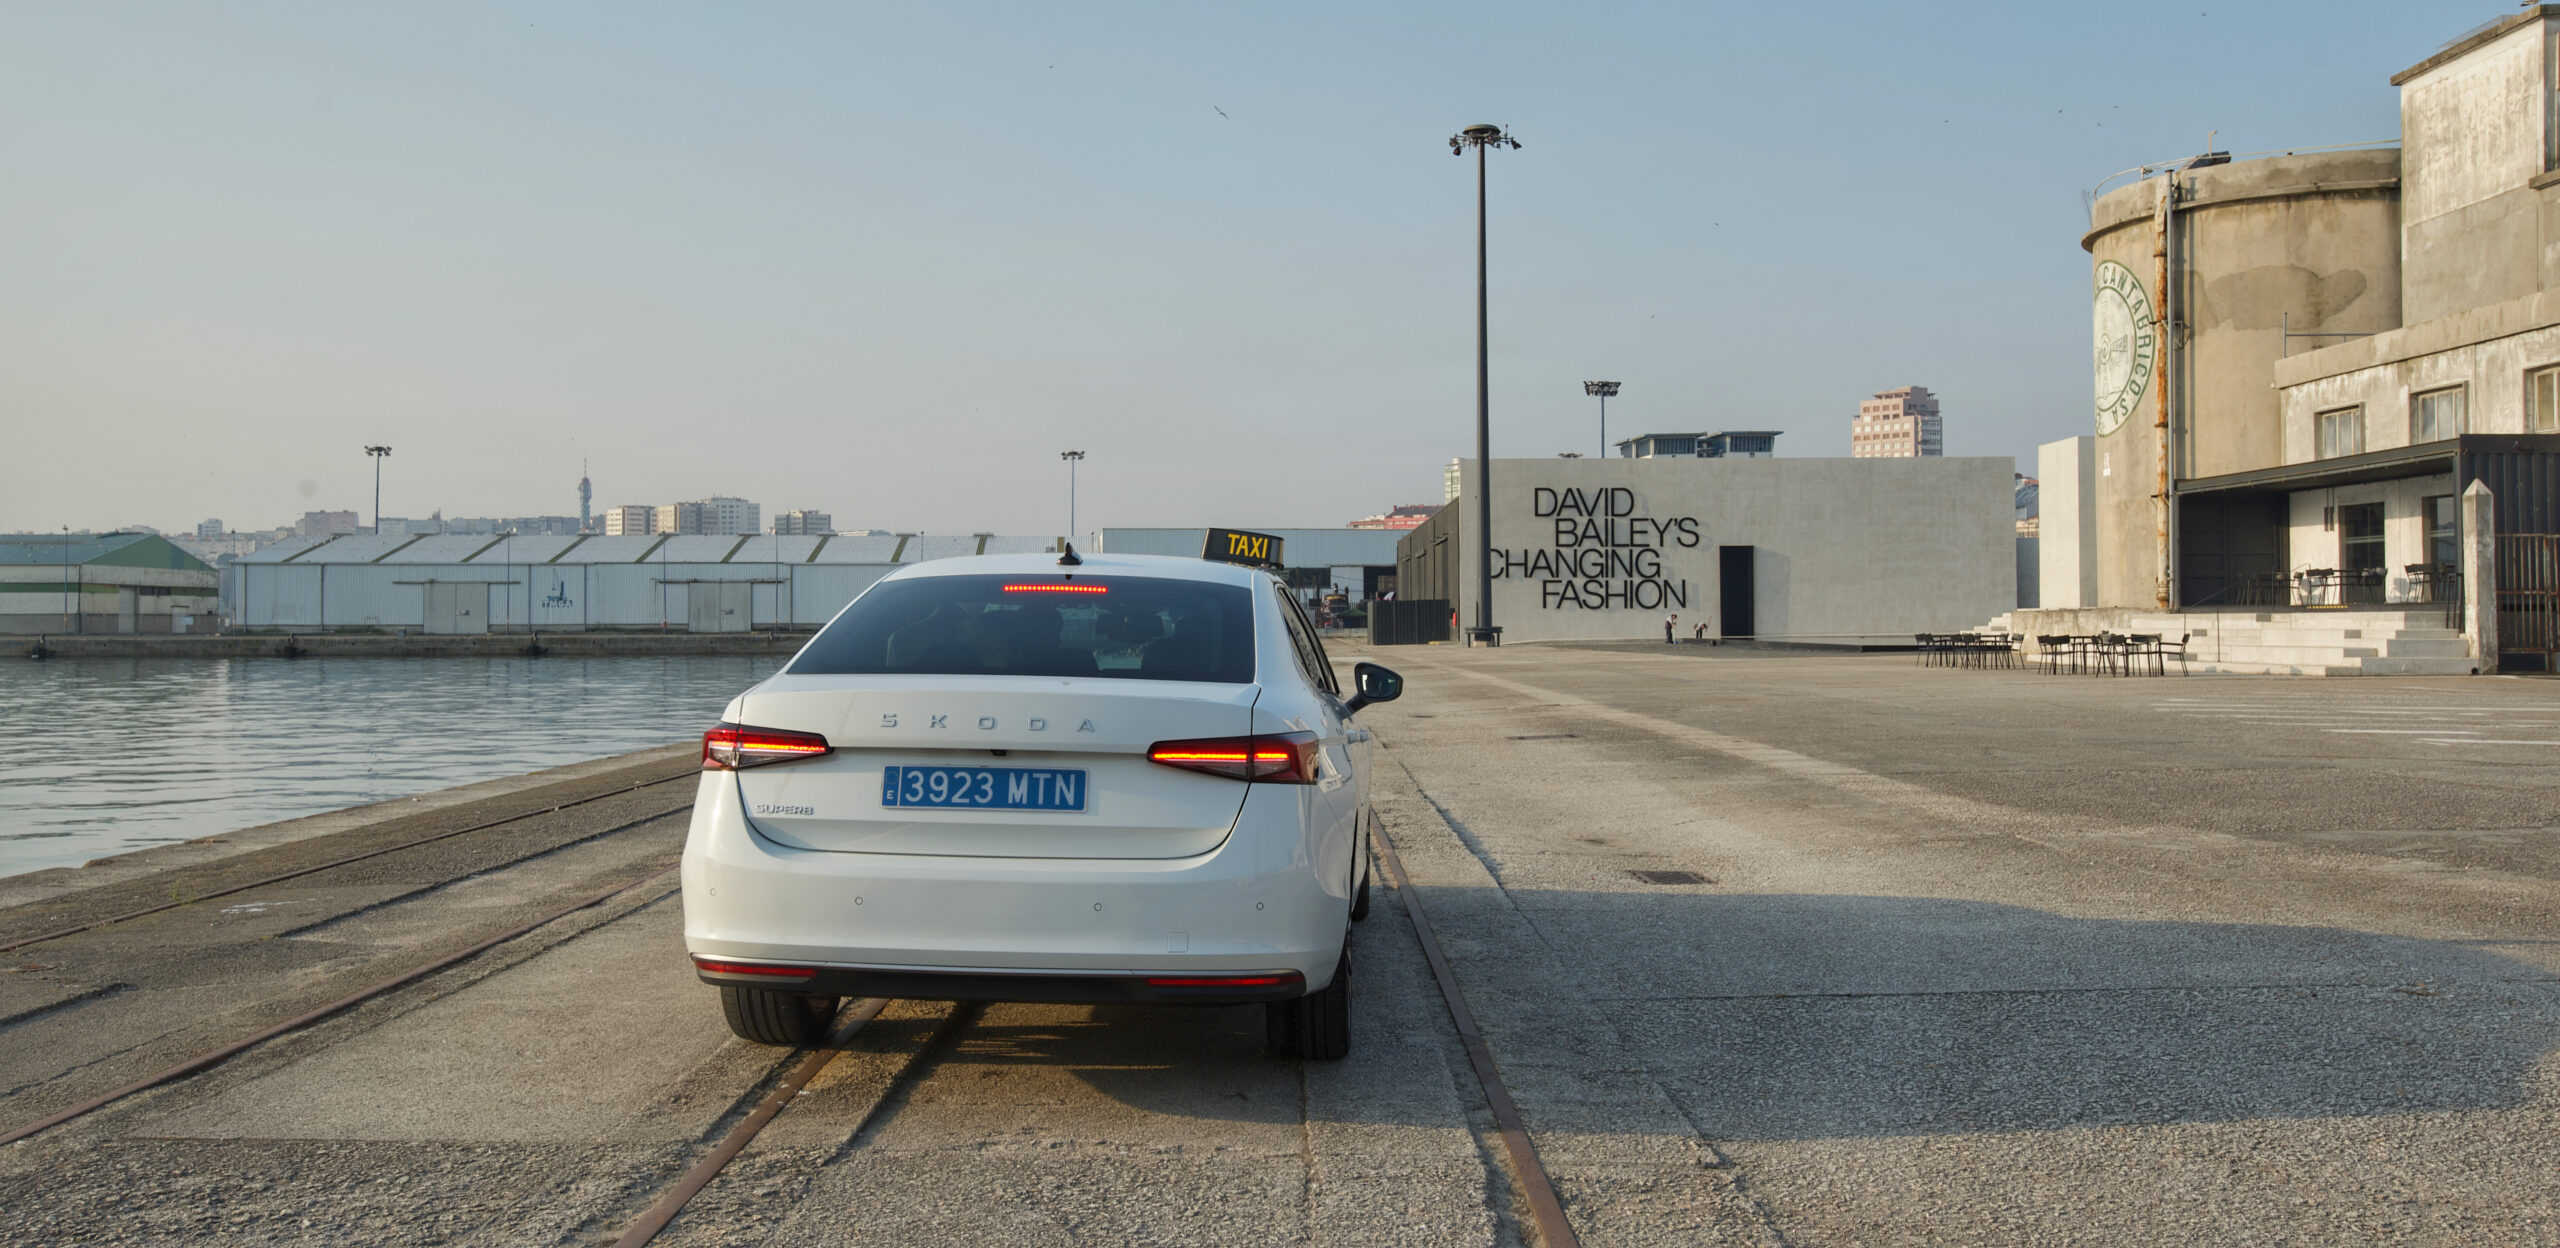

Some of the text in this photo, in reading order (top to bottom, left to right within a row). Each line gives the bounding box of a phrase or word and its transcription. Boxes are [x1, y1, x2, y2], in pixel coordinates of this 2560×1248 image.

[1534, 487, 1634, 518] DAVID
[1227, 533, 1268, 559] TAXI
[1555, 517, 1700, 548] BAILEY'S
[1490, 548, 1661, 579] CHANGING
[1542, 579, 1687, 610] FASHION
[886, 770, 1076, 806] E 3923 MTN
[755, 804, 814, 816] SUPERB
